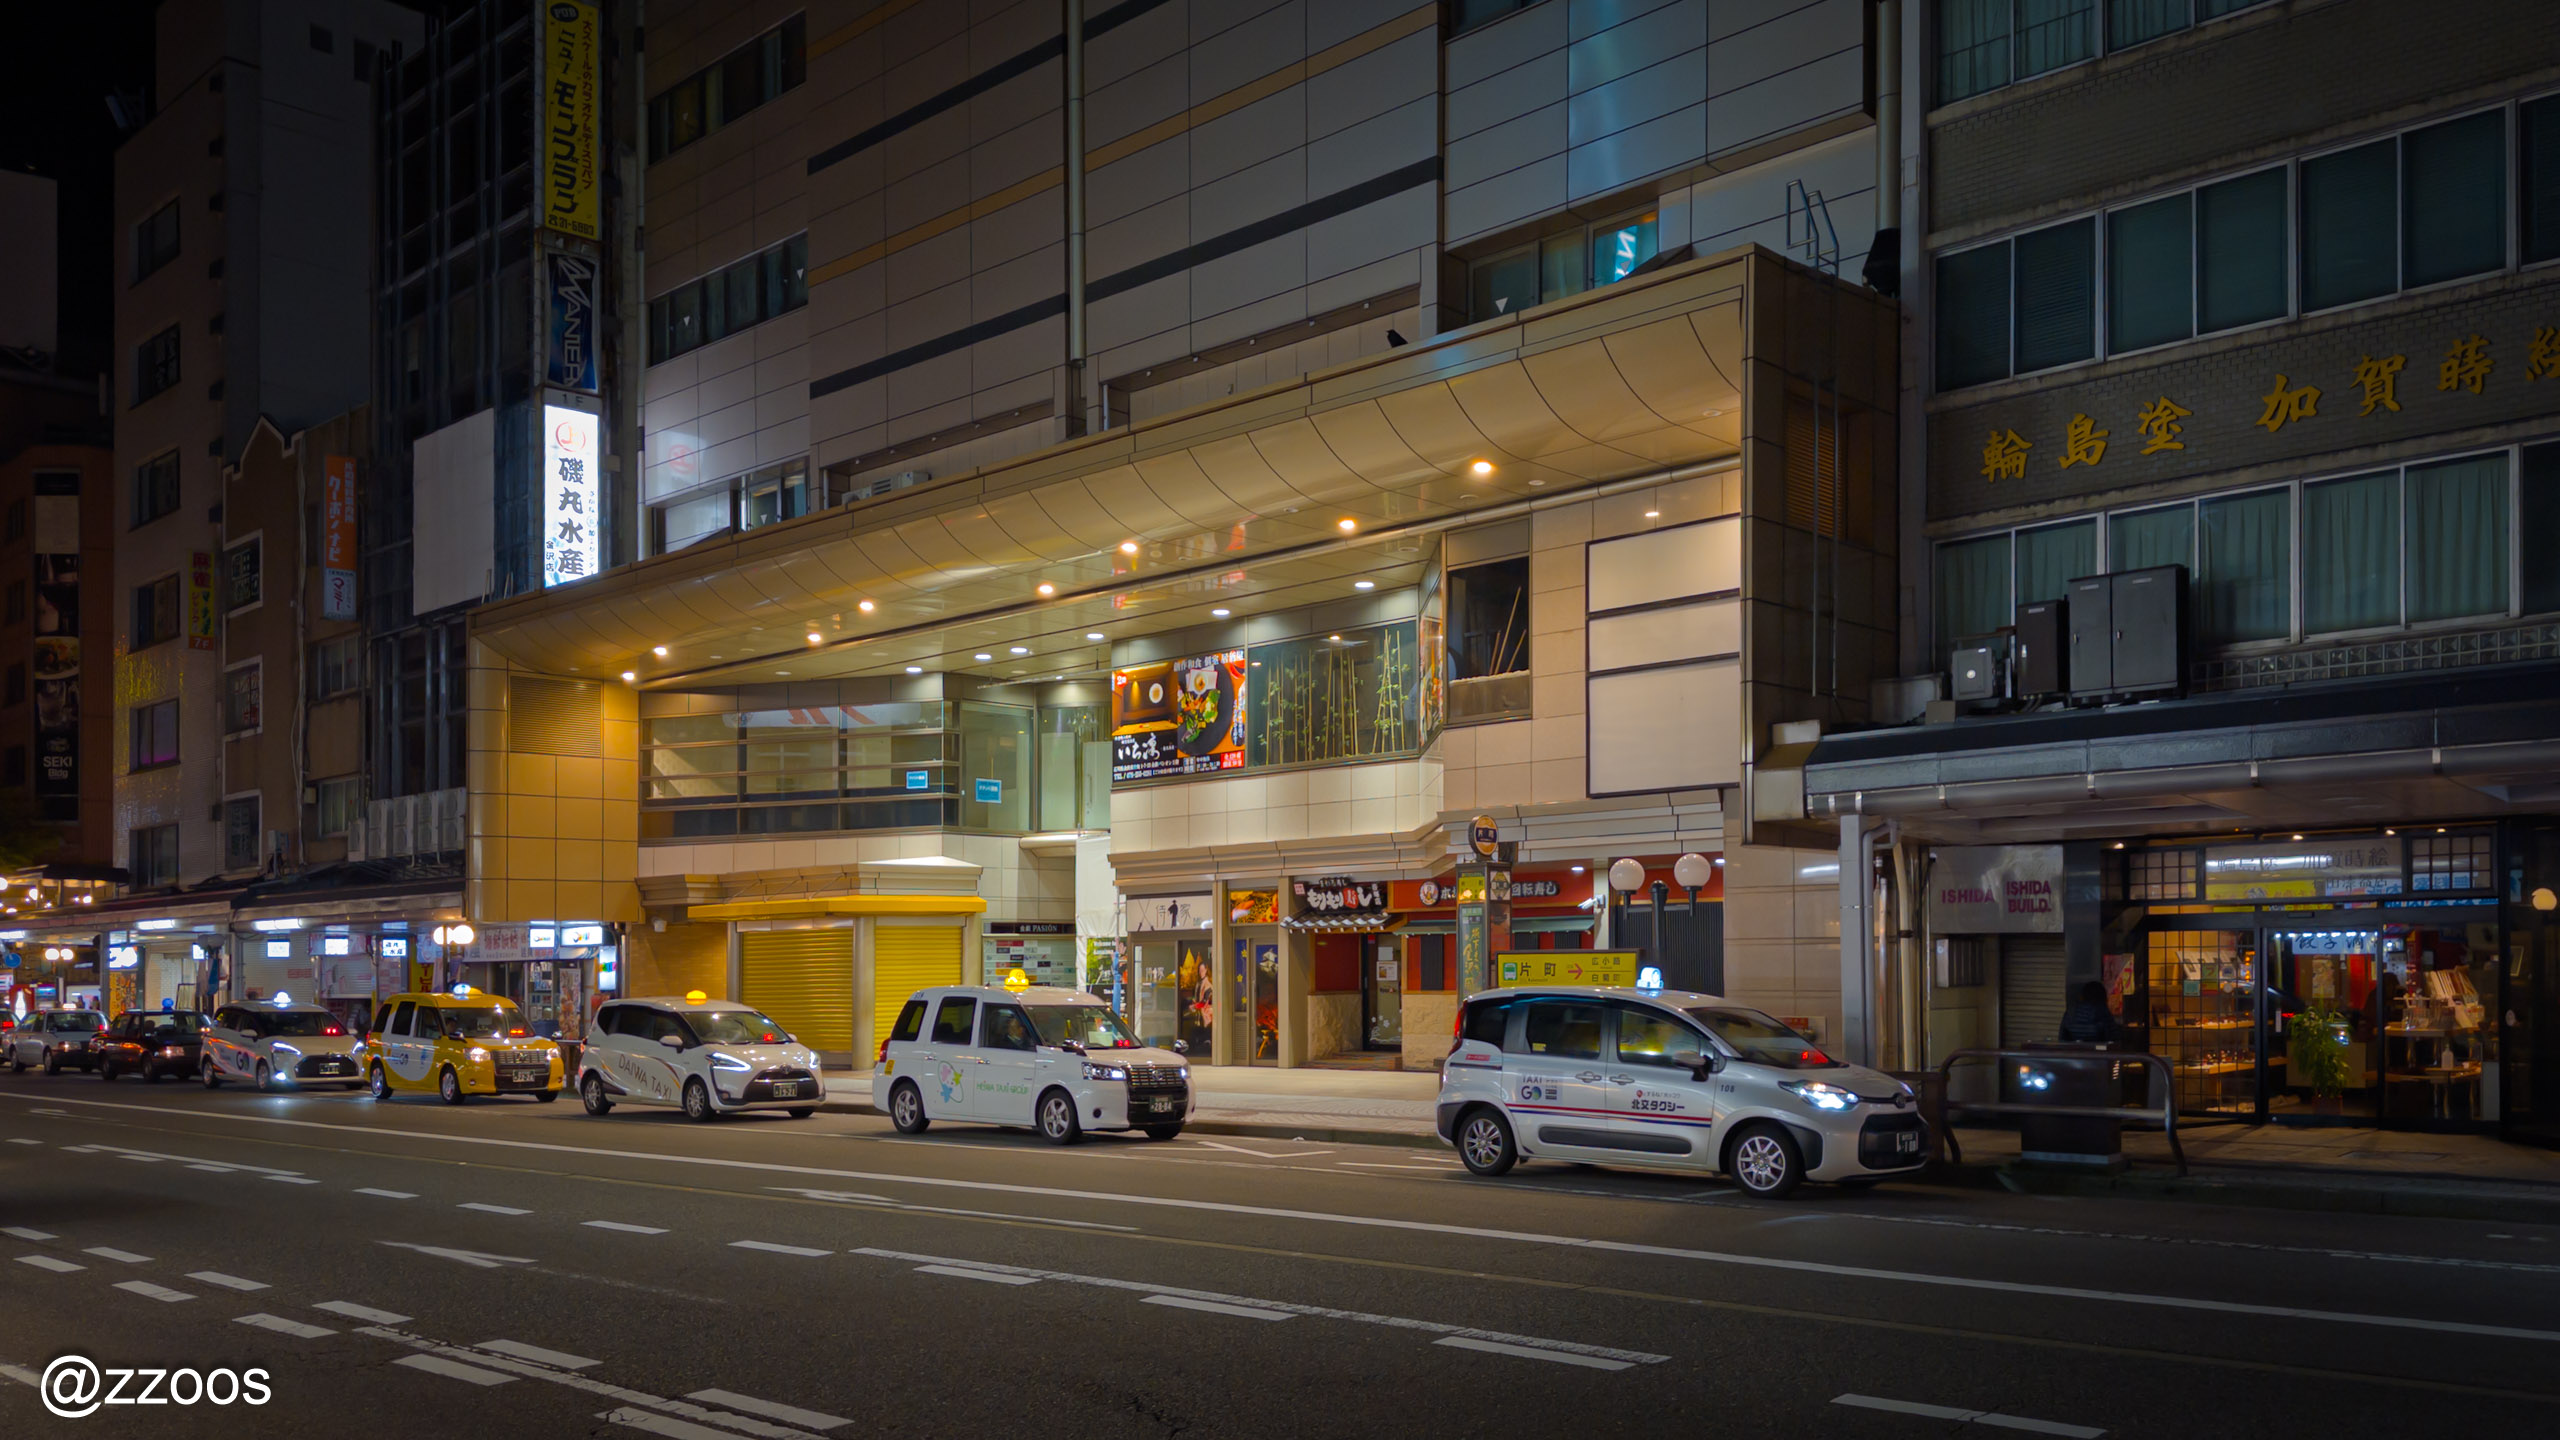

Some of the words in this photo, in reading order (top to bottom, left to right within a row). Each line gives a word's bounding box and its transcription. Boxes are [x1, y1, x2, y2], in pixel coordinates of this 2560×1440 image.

[1980, 394, 2193, 484] 輪島塗
[558, 457, 584, 576] 磯丸水産
[43, 756, 73, 767] SEKI
[2006, 880, 2051, 896] ISHIDA
[1941, 889, 1994, 904] ISHIDA
[1519, 962, 1557, 977] 片町
[236, 1051, 250, 1071] GO
[618, 1054, 647, 1087] DAIWA
[651, 1076, 672, 1101] TAXI
[1521, 1085, 1542, 1100] GO
[1631, 1098, 1685, 1112] 北交タクシー
